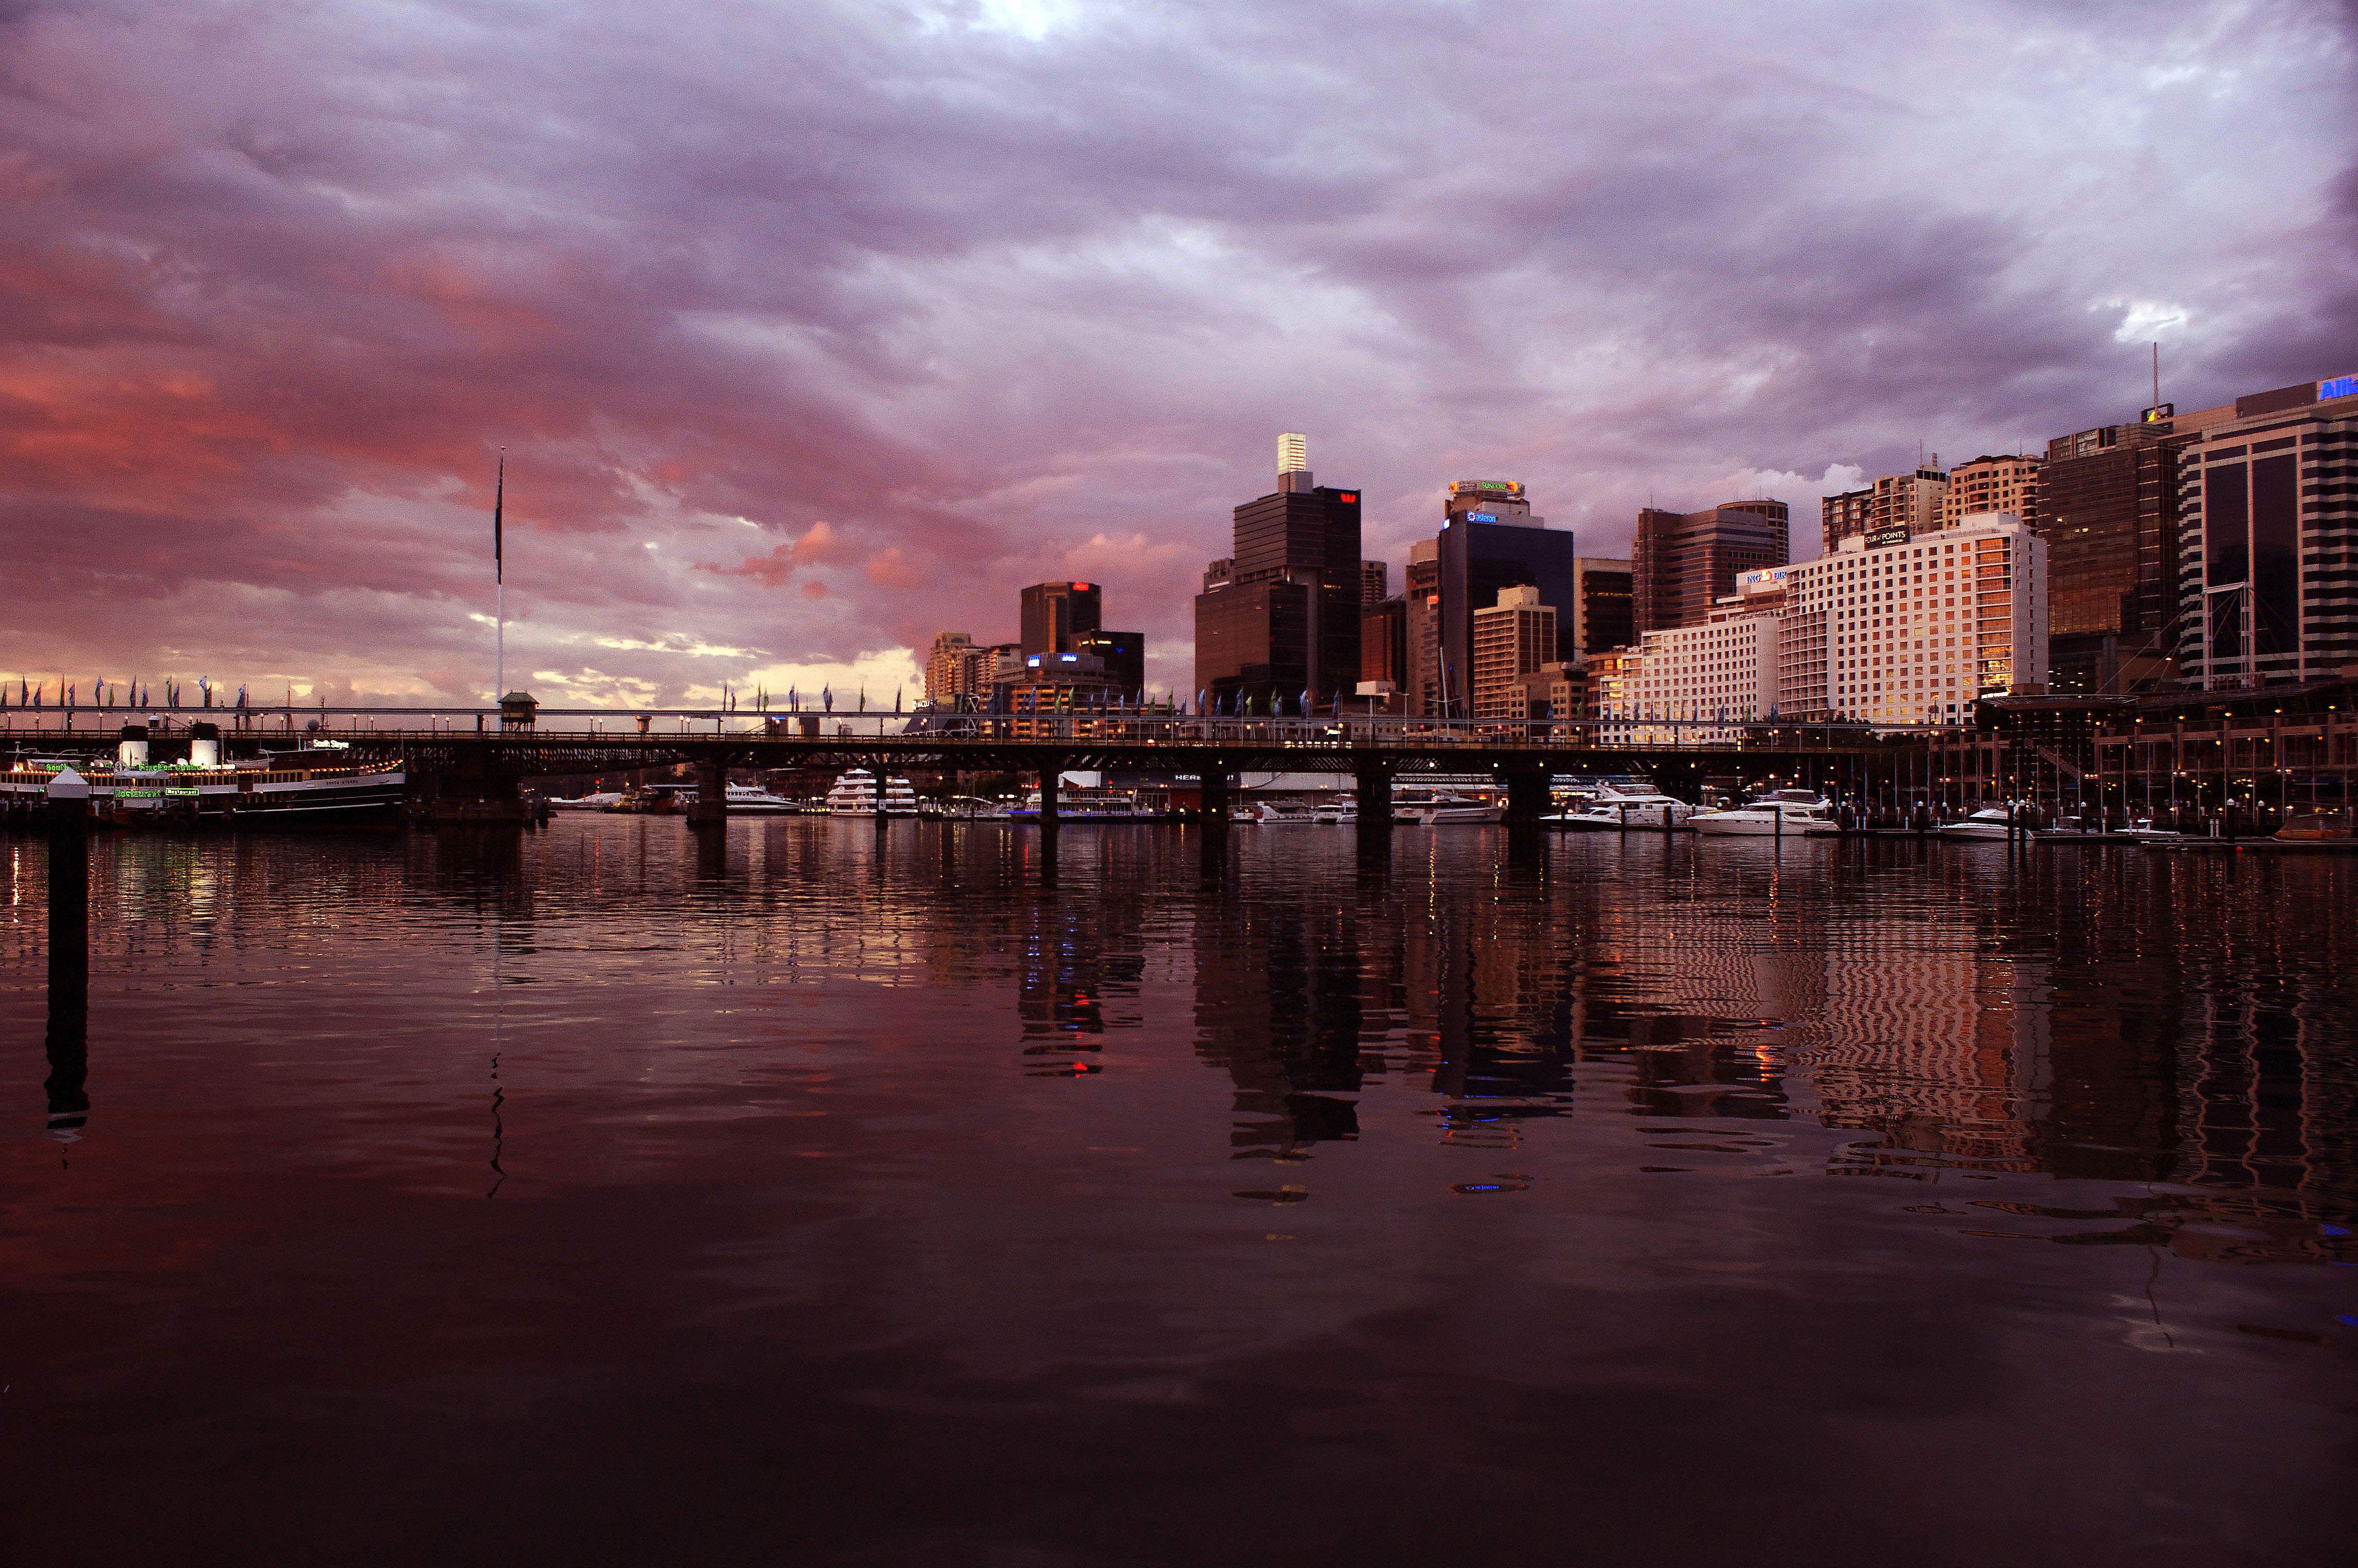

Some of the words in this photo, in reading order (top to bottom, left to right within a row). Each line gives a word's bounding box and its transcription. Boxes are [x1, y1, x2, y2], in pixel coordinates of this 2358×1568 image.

[1476, 514, 1496, 523] asteron
[1882, 531, 1905, 540] POINTS
[1745, 575, 1760, 583] ING
